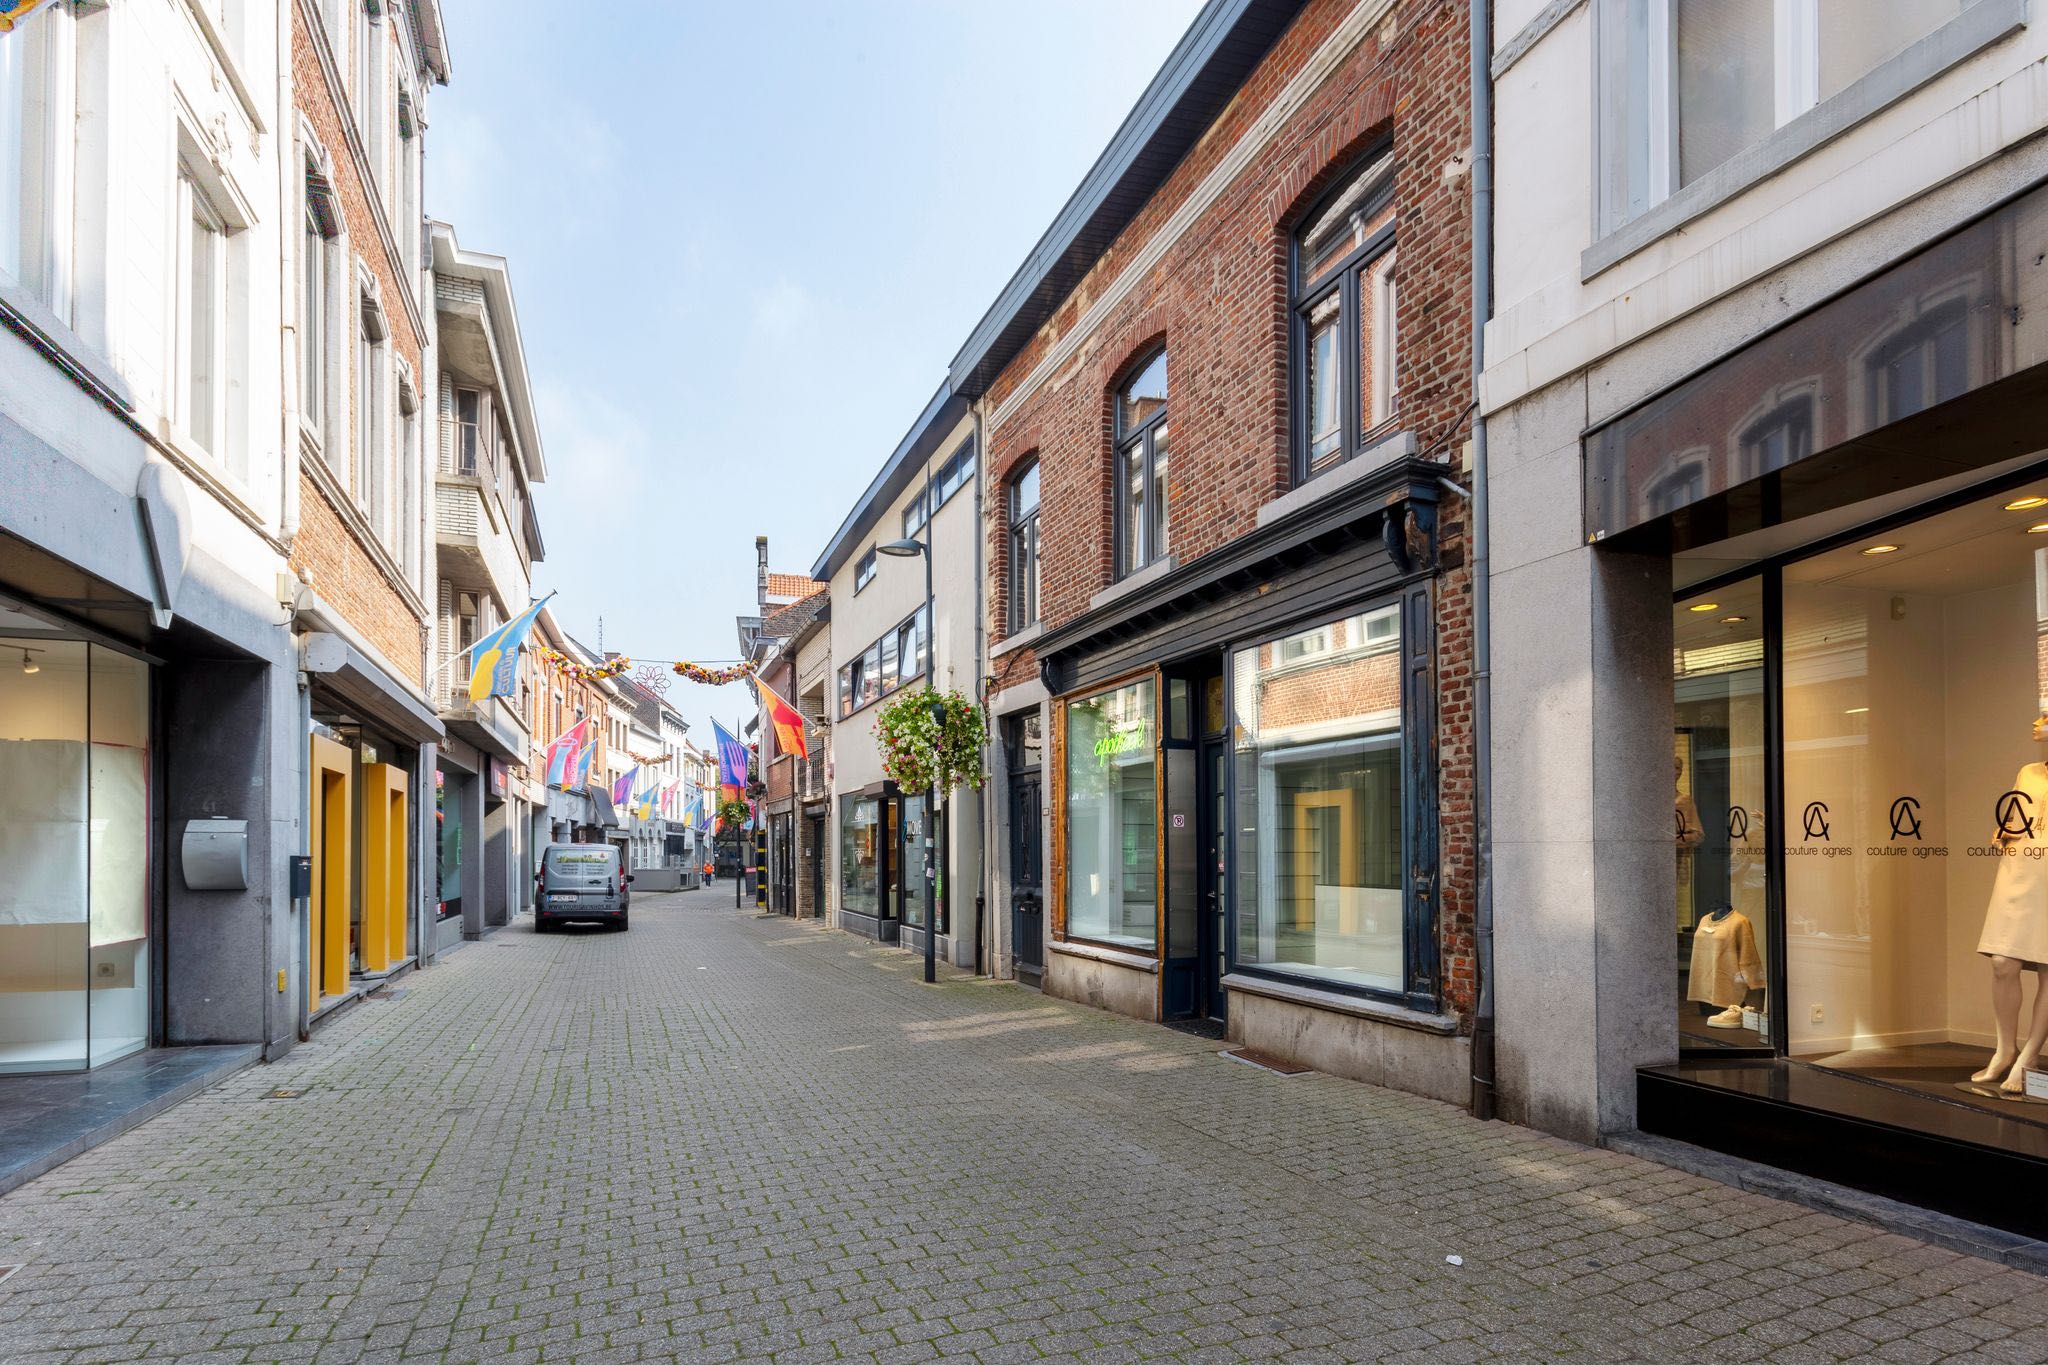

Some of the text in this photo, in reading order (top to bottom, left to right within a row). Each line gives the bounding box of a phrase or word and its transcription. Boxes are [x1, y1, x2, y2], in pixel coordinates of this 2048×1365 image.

[1784, 846, 1852, 858] couture agnes
[1866, 845, 1949, 859] couture agnes
[1966, 844, 2017, 857] couture
